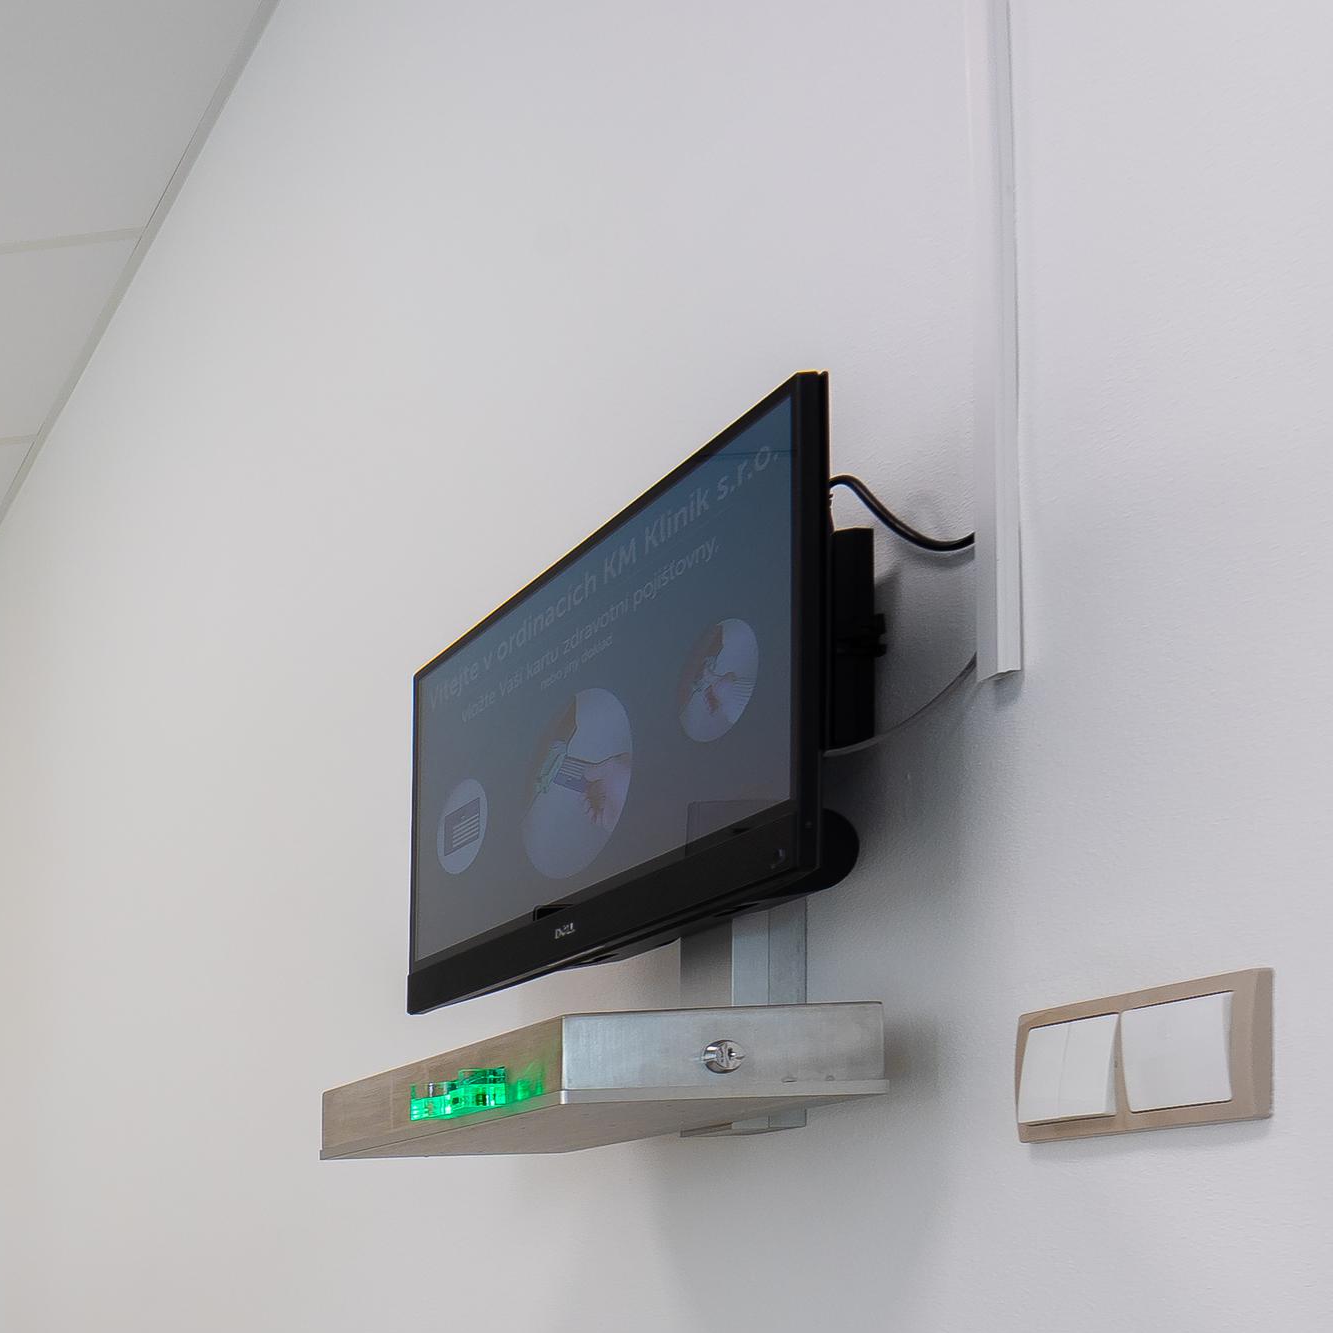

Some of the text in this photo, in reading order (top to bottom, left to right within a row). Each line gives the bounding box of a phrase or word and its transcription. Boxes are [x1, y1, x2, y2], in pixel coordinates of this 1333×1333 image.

[483, 653, 496, 670] v
[497, 571, 598, 661] ordinacích
[603, 538, 637, 584] KM
[644, 487, 710, 555] Klinik
[717, 446, 779, 500] s.r.o.
